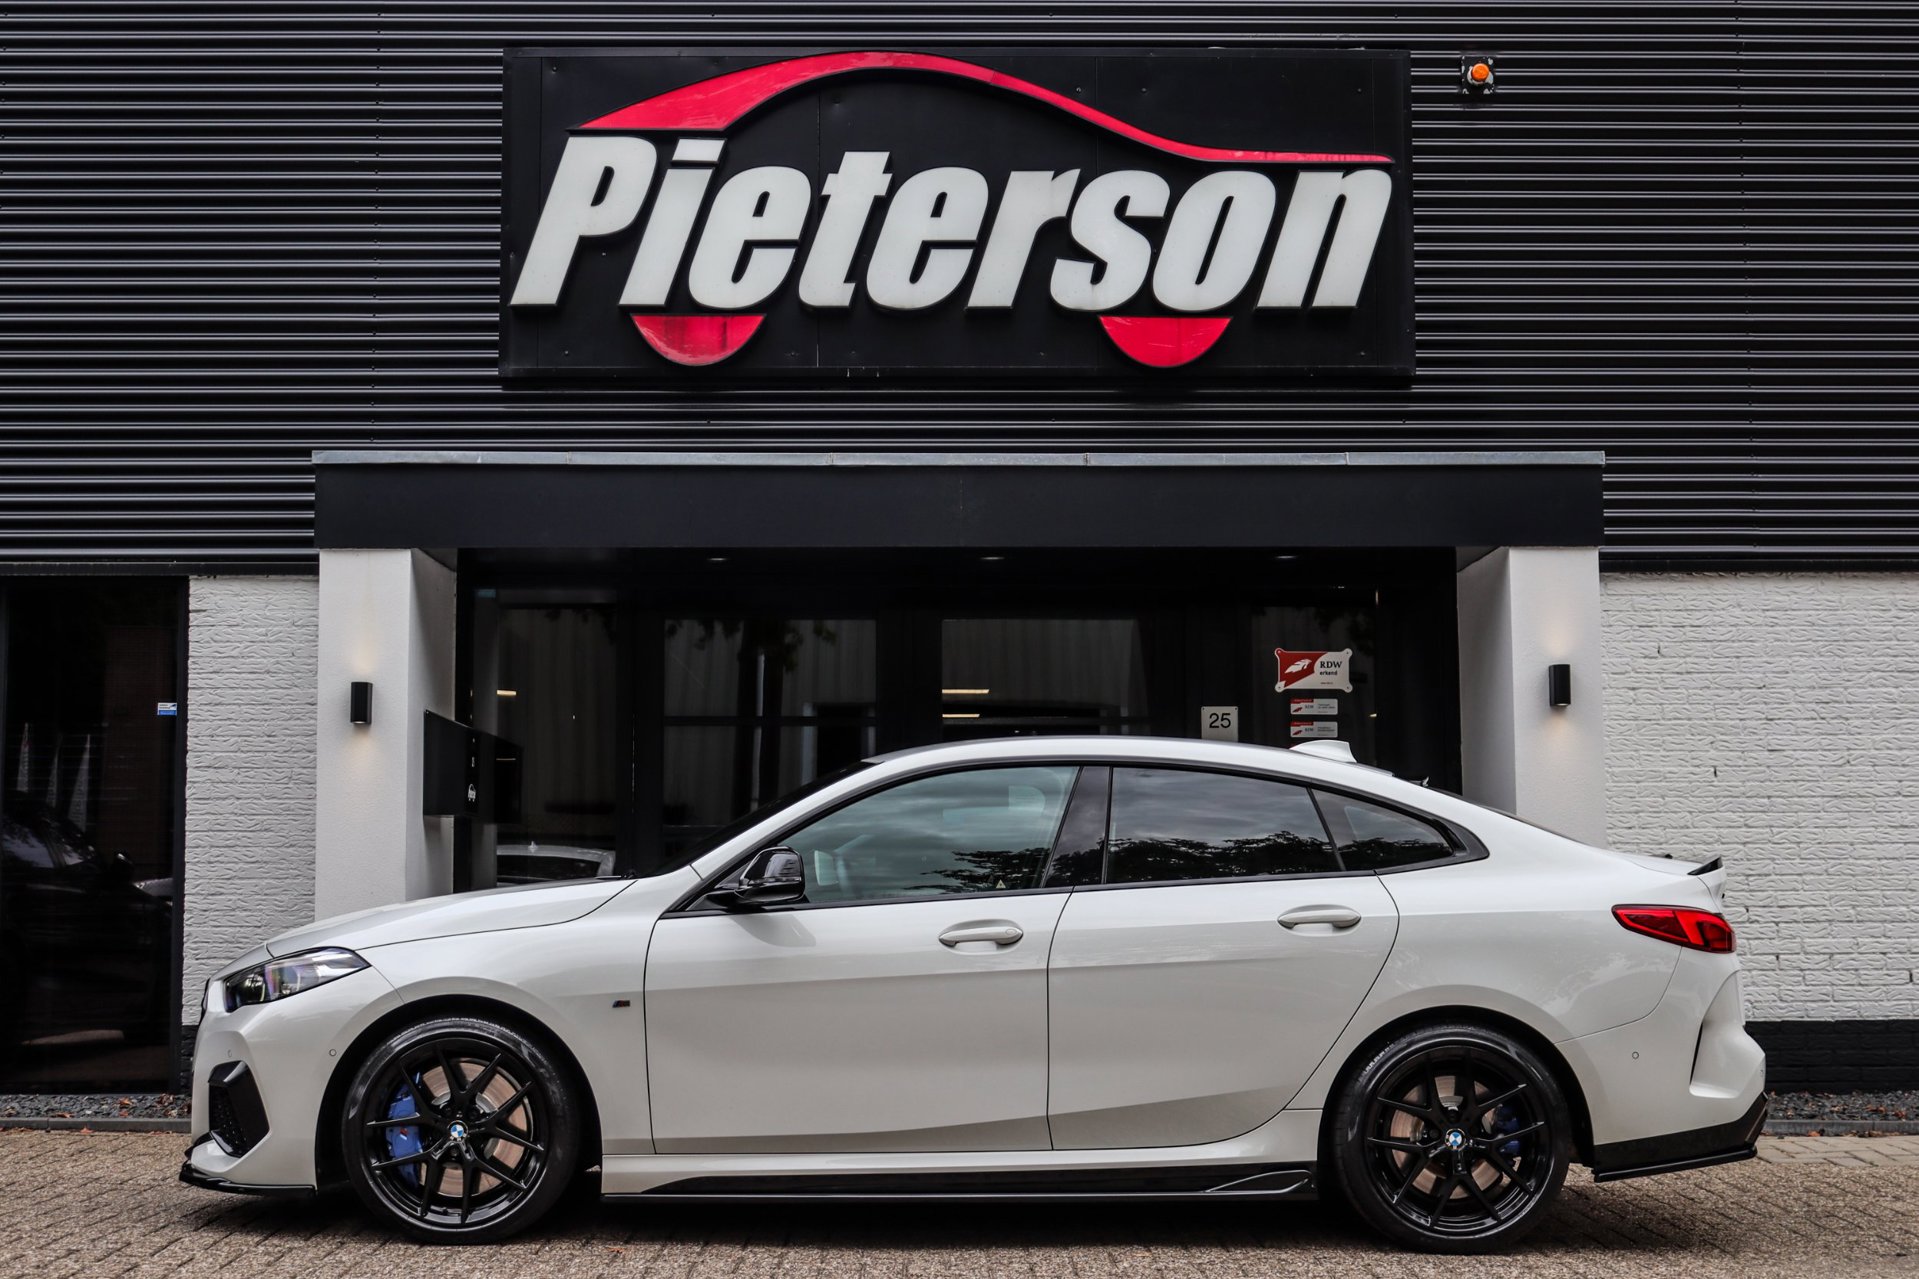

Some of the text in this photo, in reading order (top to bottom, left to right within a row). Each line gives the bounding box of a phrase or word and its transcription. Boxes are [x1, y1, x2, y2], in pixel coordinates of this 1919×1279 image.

[511, 137, 1393, 310] Pieterson
[1320, 661, 1343, 669] RDW
[1209, 712, 1231, 729] 25
